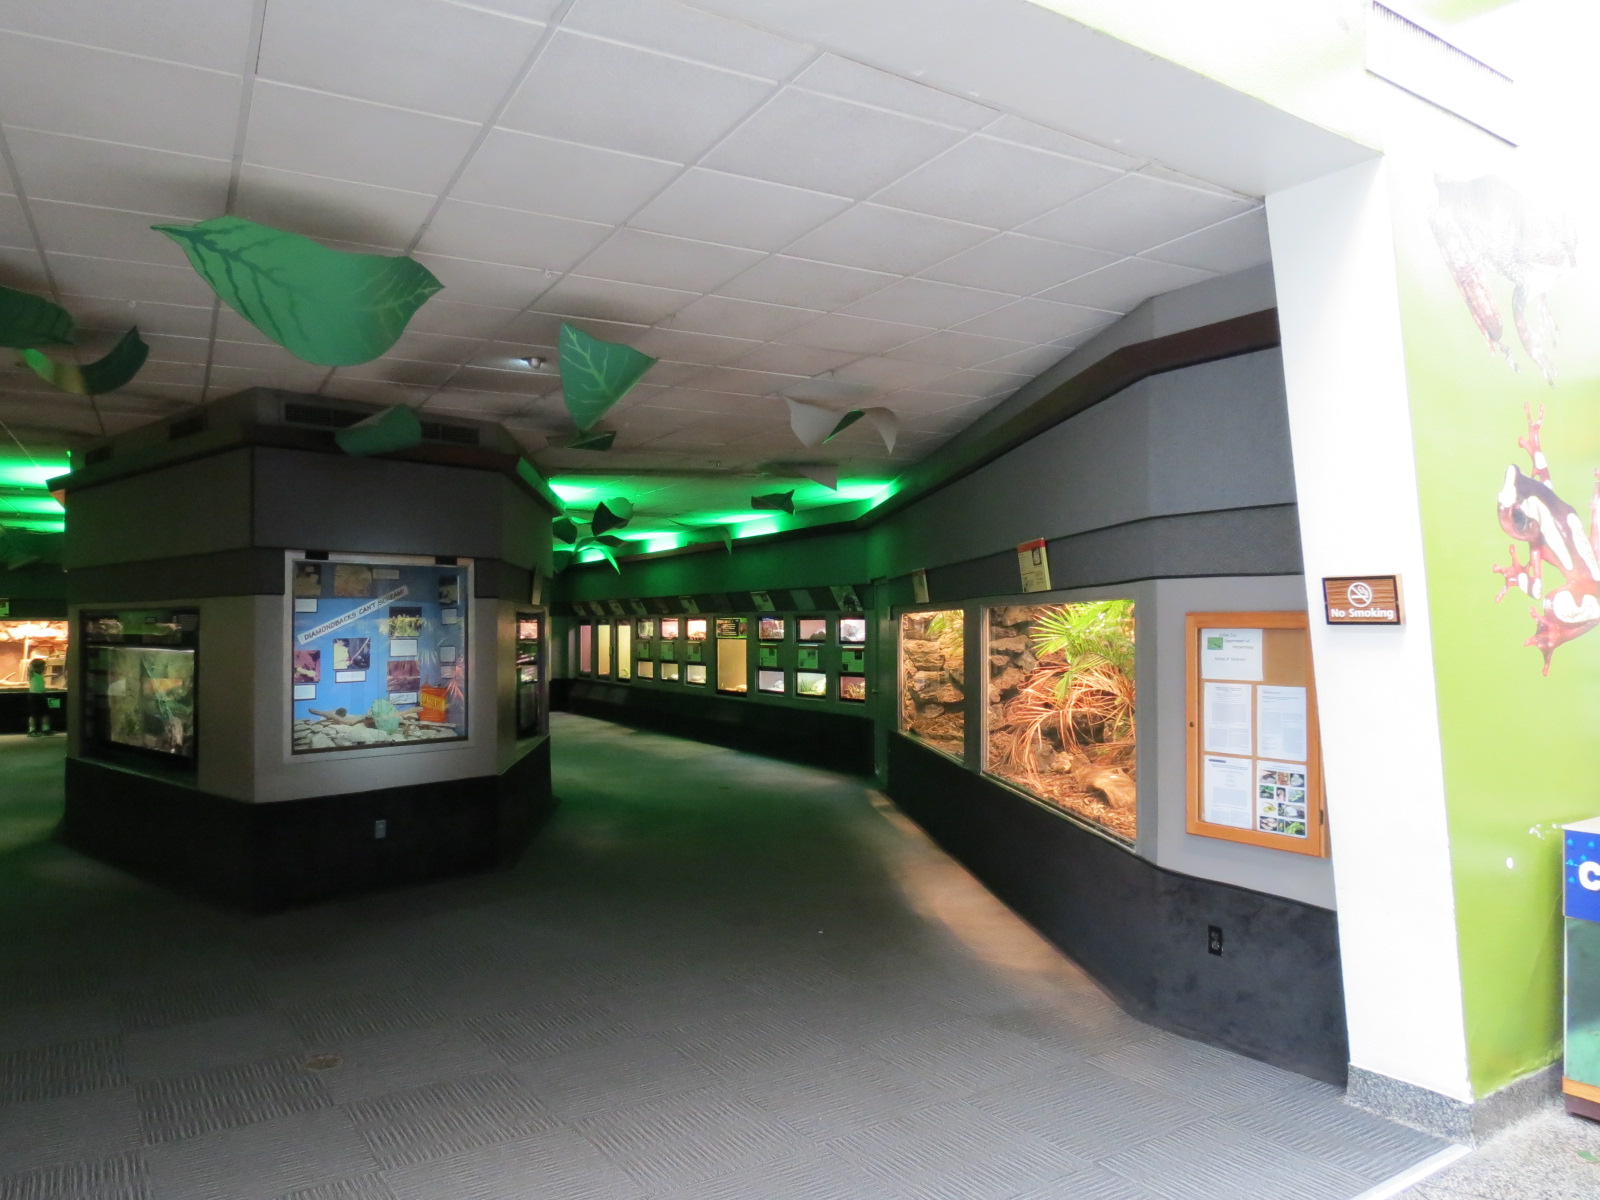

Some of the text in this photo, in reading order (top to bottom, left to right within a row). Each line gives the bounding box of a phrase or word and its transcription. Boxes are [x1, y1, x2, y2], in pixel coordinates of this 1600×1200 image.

[304, 613, 357, 640] DIAMONDBACKS
[358, 602, 377, 615] CAN'T
[1330, 607, 1394, 619] No Smoking
